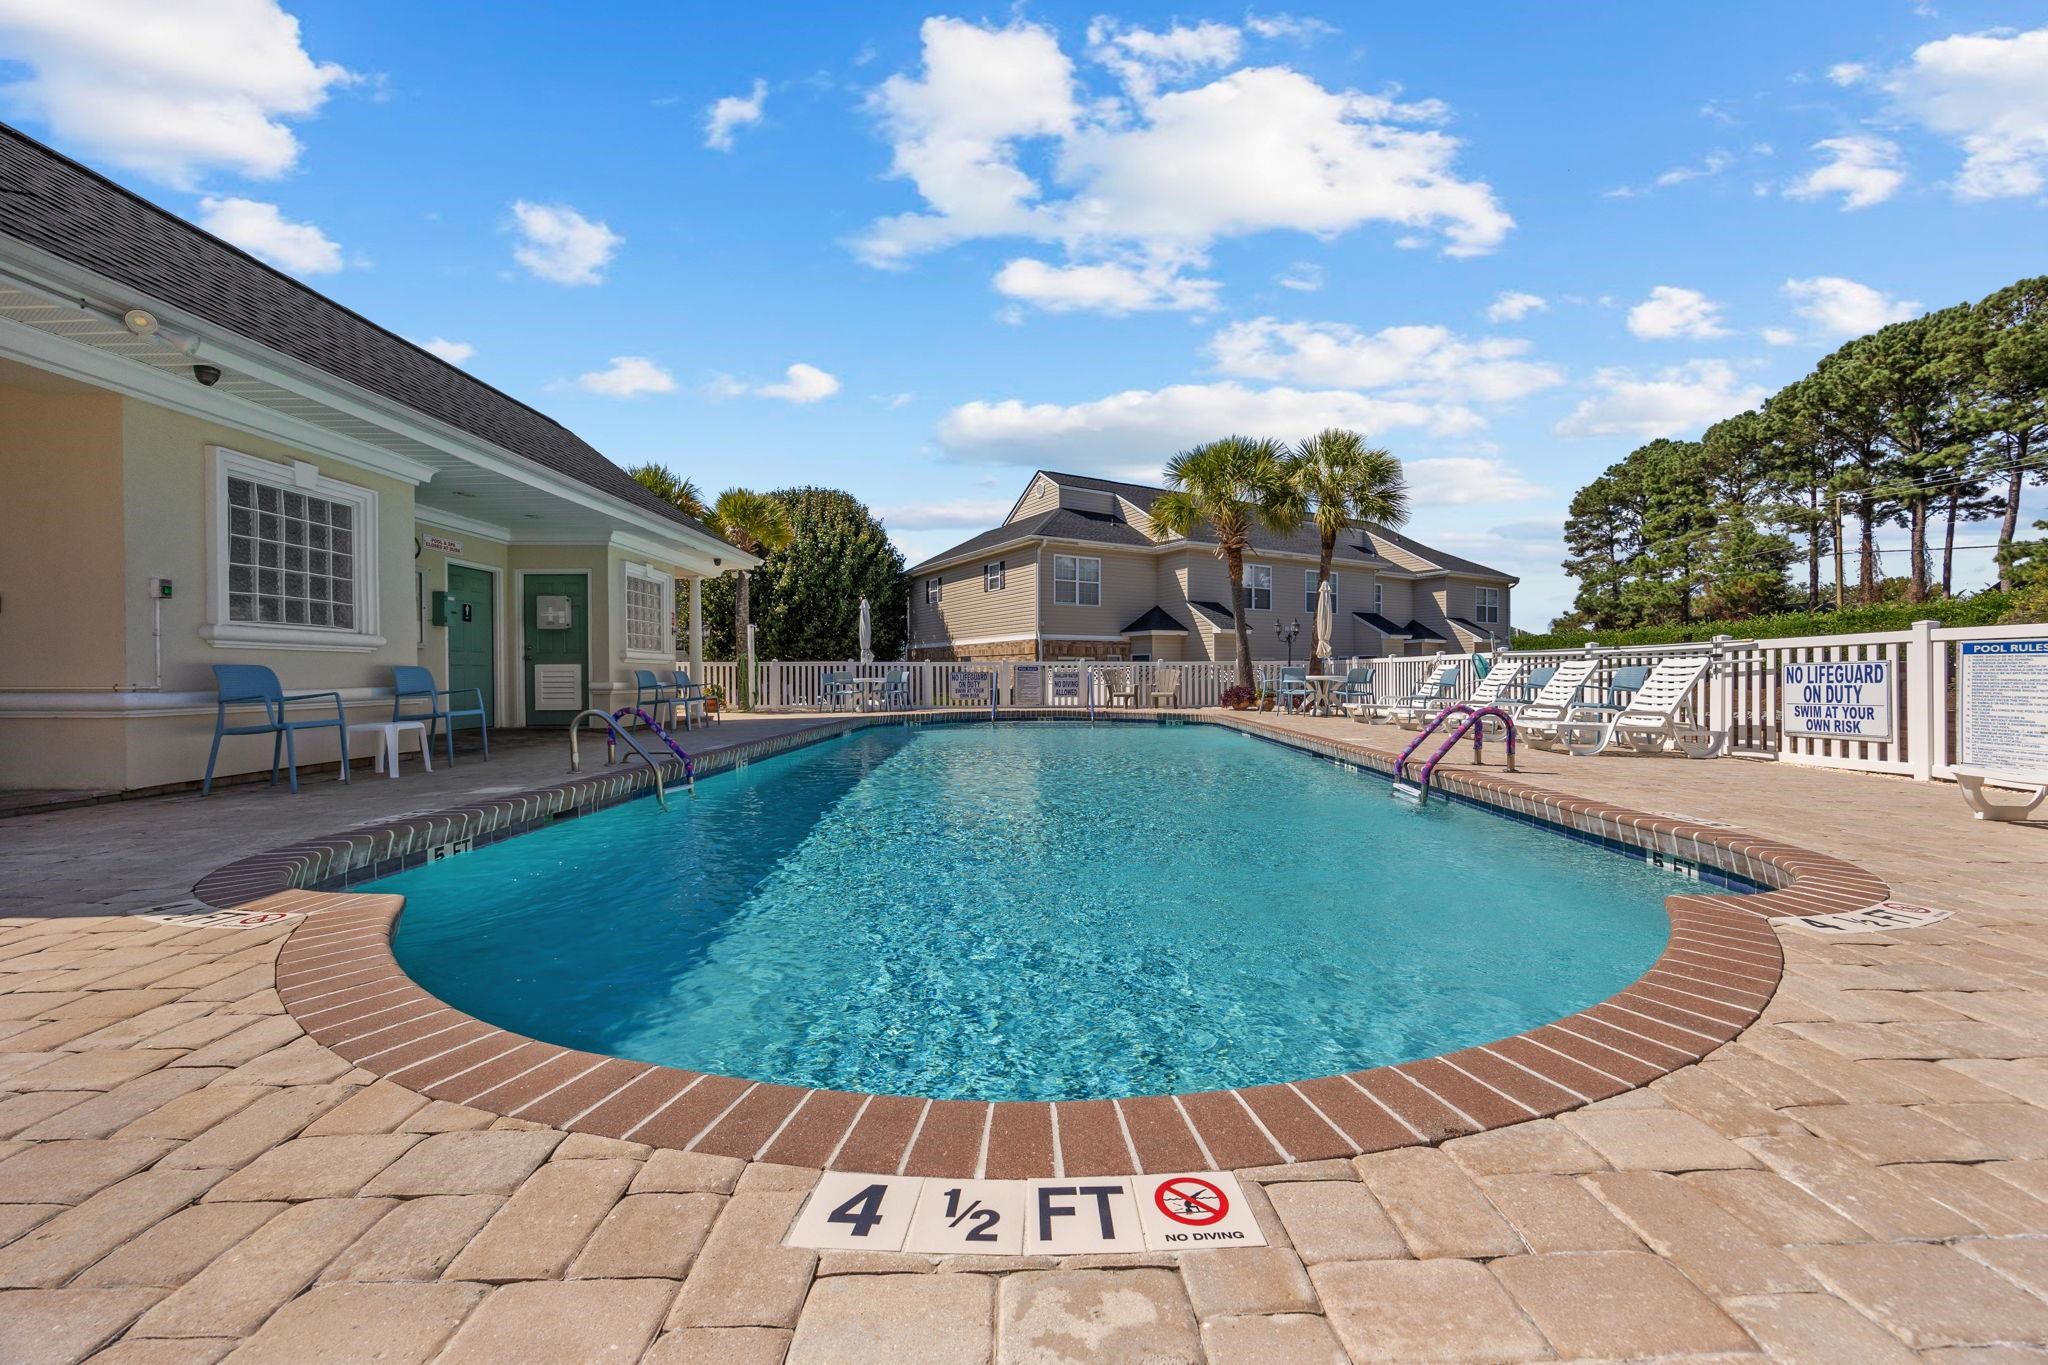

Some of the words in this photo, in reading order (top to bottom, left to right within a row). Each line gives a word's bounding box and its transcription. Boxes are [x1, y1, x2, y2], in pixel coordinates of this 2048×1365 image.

[1974, 644, 2007, 653] POOL
[960, 673, 988, 681] LIFEGUARD
[1786, 666, 1803, 684] NO
[1807, 664, 1884, 684] LIFEGUARD
[1054, 680, 1061, 688] NO
[1062, 680, 1079, 688] DIVING
[1803, 685, 1821, 703] ON
[1826, 684, 1863, 704] DUTY
[1794, 705, 1822, 718] SWIM
[1825, 706, 1838, 719] AT
[1842, 706, 1875, 720] YOUR
[1806, 719, 1830, 732] OWN
[1834, 720, 1861, 734] RISK
[434, 846, 445, 861] 5
[453, 839, 471, 856] FT
[1652, 851, 1664, 867] 5
[1673, 857, 1696, 876] FT
[827, 1184, 888, 1237] 4
[1036, 1185, 1124, 1241] FT
[1165, 1233, 1188, 1242] NO
[1192, 1231, 1245, 1241] DIVING
